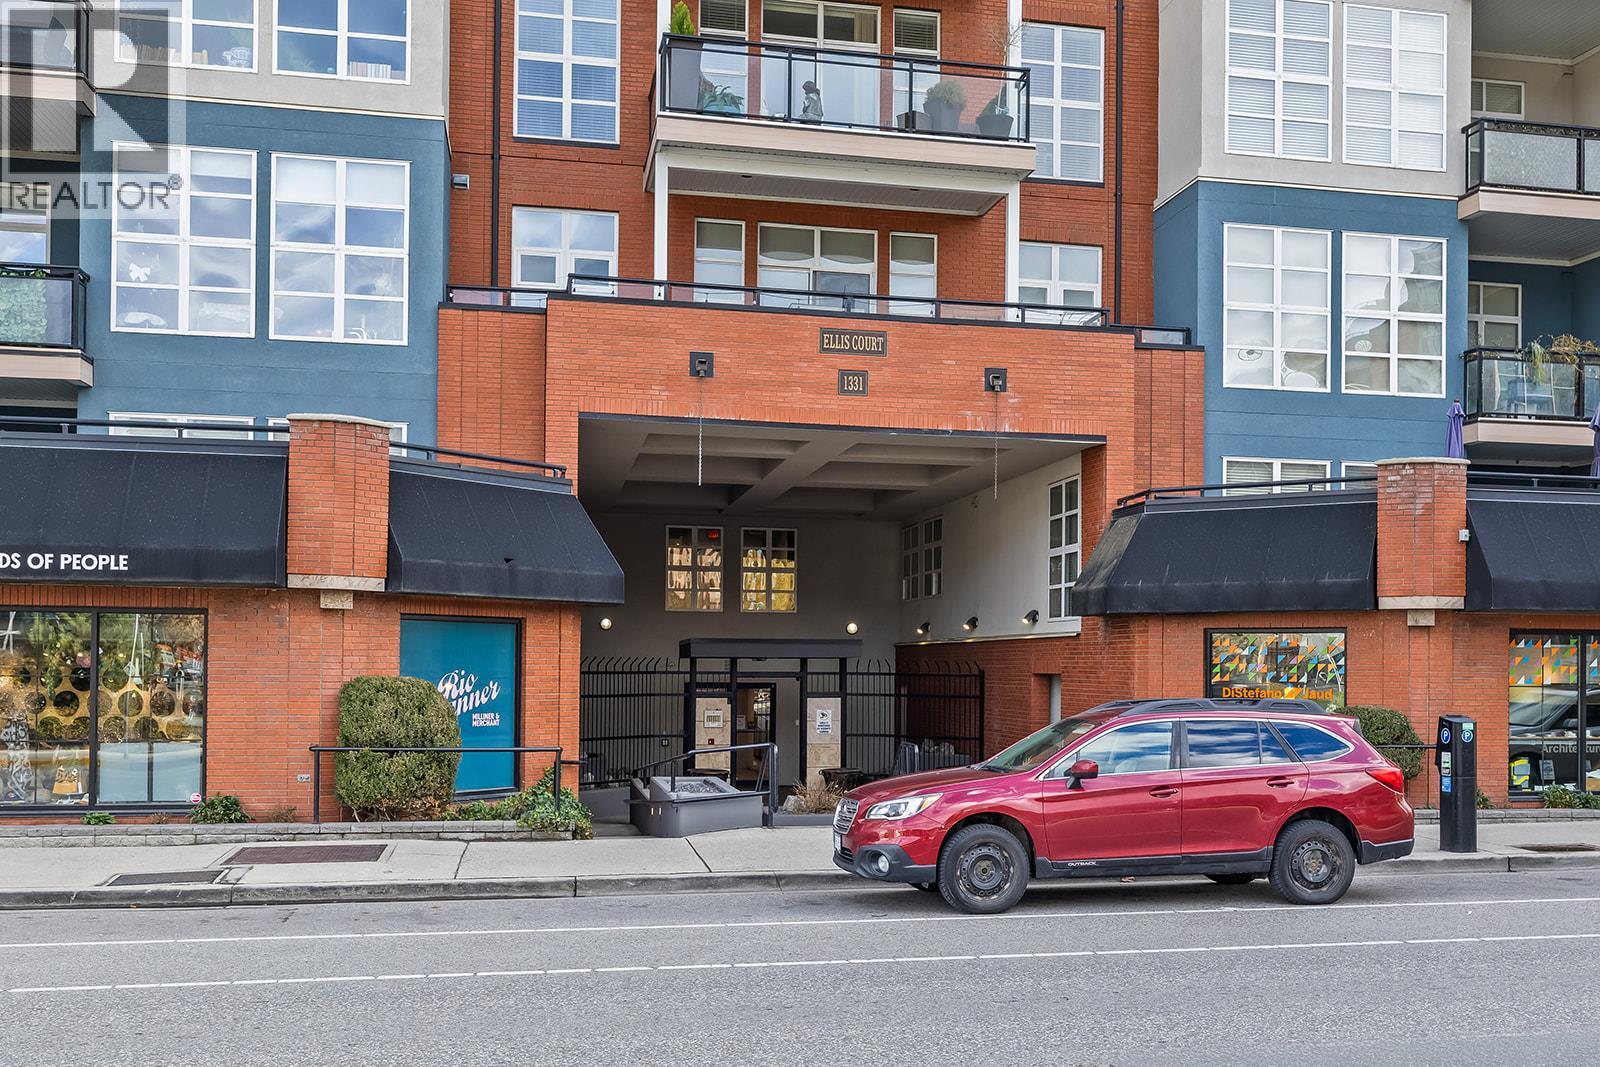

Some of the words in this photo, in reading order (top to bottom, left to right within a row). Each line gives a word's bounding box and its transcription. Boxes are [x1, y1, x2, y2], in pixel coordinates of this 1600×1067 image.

[823, 334, 850, 350] ELLIS
[852, 335, 884, 351] COURT
[844, 375, 863, 391] 1331
[27, 553, 54, 569] OF
[60, 553, 129, 571] PEOPLE
[437, 670, 478, 700] Rio
[1222, 687, 1282, 699] DiStefano
